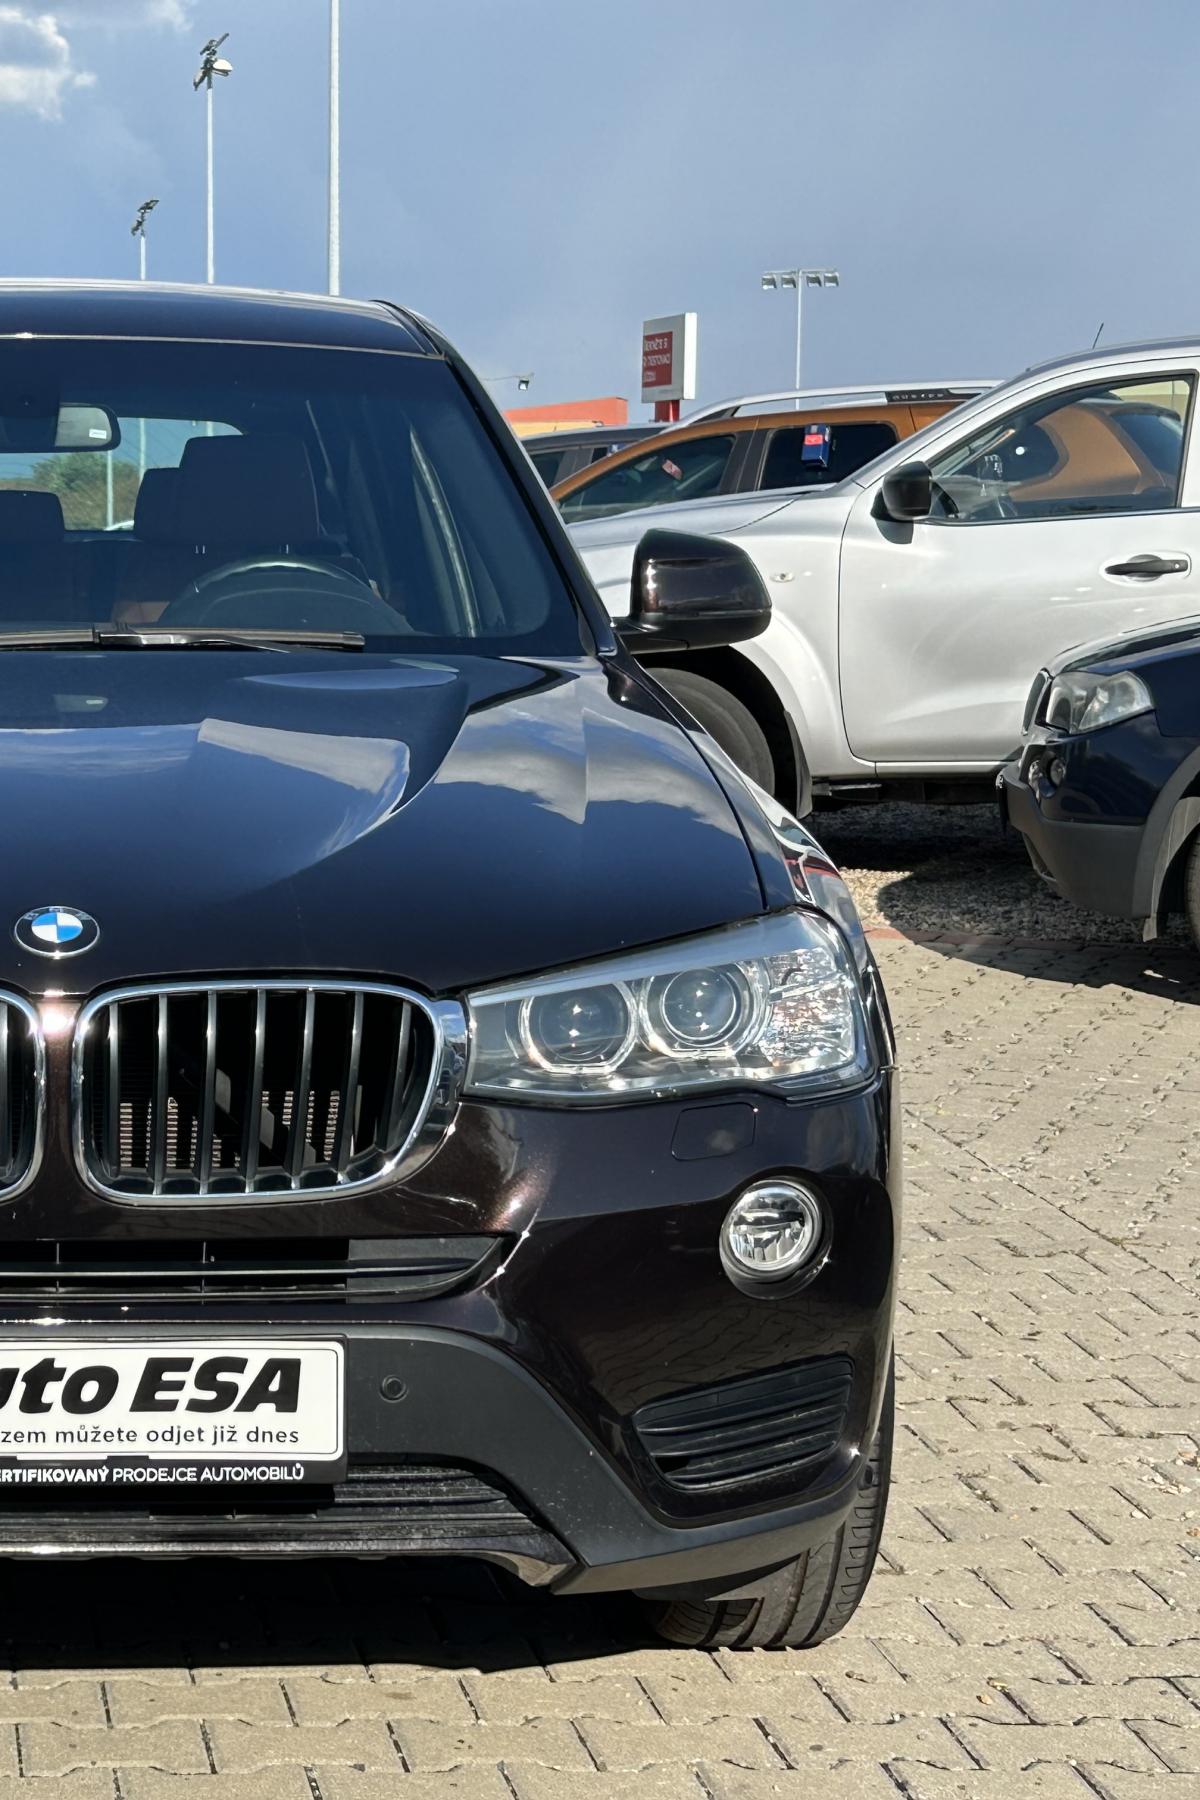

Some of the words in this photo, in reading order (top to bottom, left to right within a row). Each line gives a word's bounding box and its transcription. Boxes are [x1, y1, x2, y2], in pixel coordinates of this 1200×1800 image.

[130, 1356, 302, 1414] ESA
[55, 1425, 138, 1443] můžete
[146, 1426, 205, 1446] odjet
[211, 1425, 238, 1446] již
[246, 1426, 299, 1443] dnes
[112, 1467, 198, 1482] PRODEJCE
[200, 1463, 304, 1482] AUTOMOBILŮ
